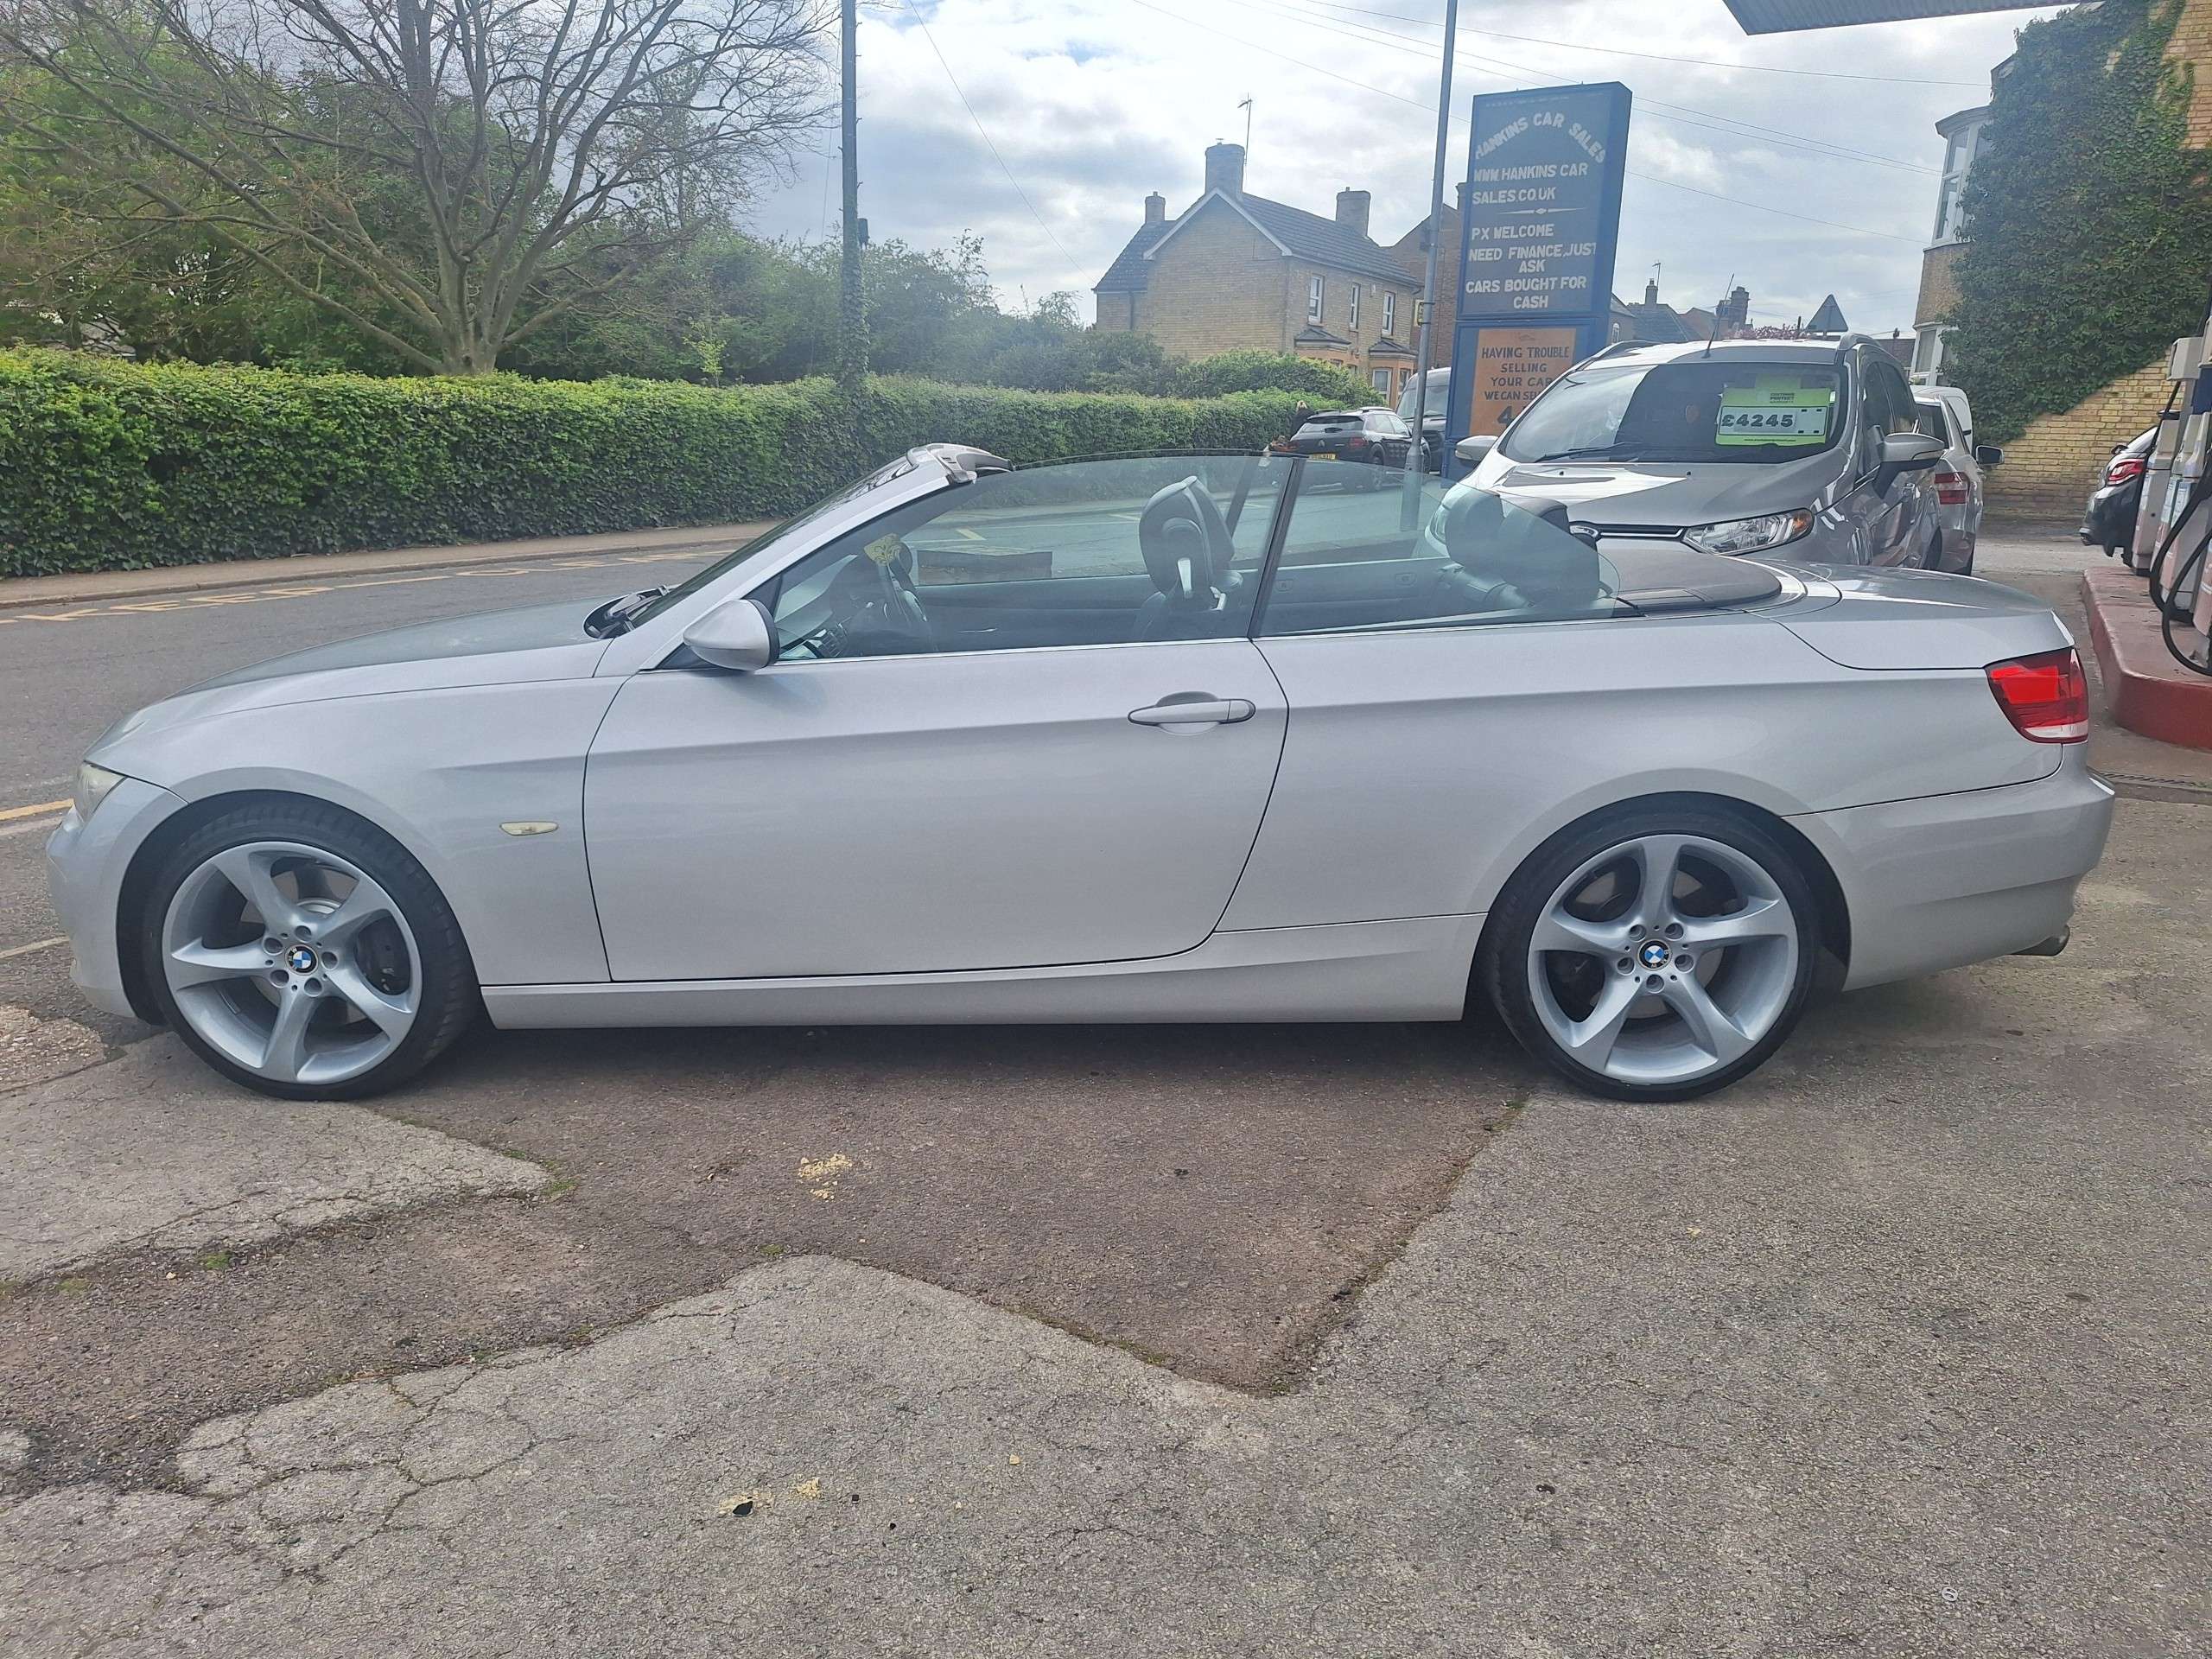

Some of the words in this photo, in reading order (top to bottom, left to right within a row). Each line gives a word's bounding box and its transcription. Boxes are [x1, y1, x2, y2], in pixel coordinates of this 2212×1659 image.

[1533, 111, 1565, 128] CAR
[1568, 122, 1606, 164] SALES
[1560, 162, 1588, 177] CAR
[1471, 227, 1490, 240] PX
[1493, 224, 1554, 239] WELCOME
[1469, 248, 1503, 262] NEED
[1518, 259, 1546, 273] ASK
[1465, 280, 1501, 295] CARS
[1504, 277, 1558, 293] BOUGHT
[1560, 276, 1587, 289] FOR
[1513, 296, 1549, 309] CASH
[1481, 347, 1522, 359] HAVING
[1527, 346, 1570, 359] TROUBLE
[1500, 363, 1548, 373] SELLING
[1491, 377, 1522, 387] YOUR
[1721, 414, 1794, 428] £4245
[14, 587, 335, 622] KEEP
